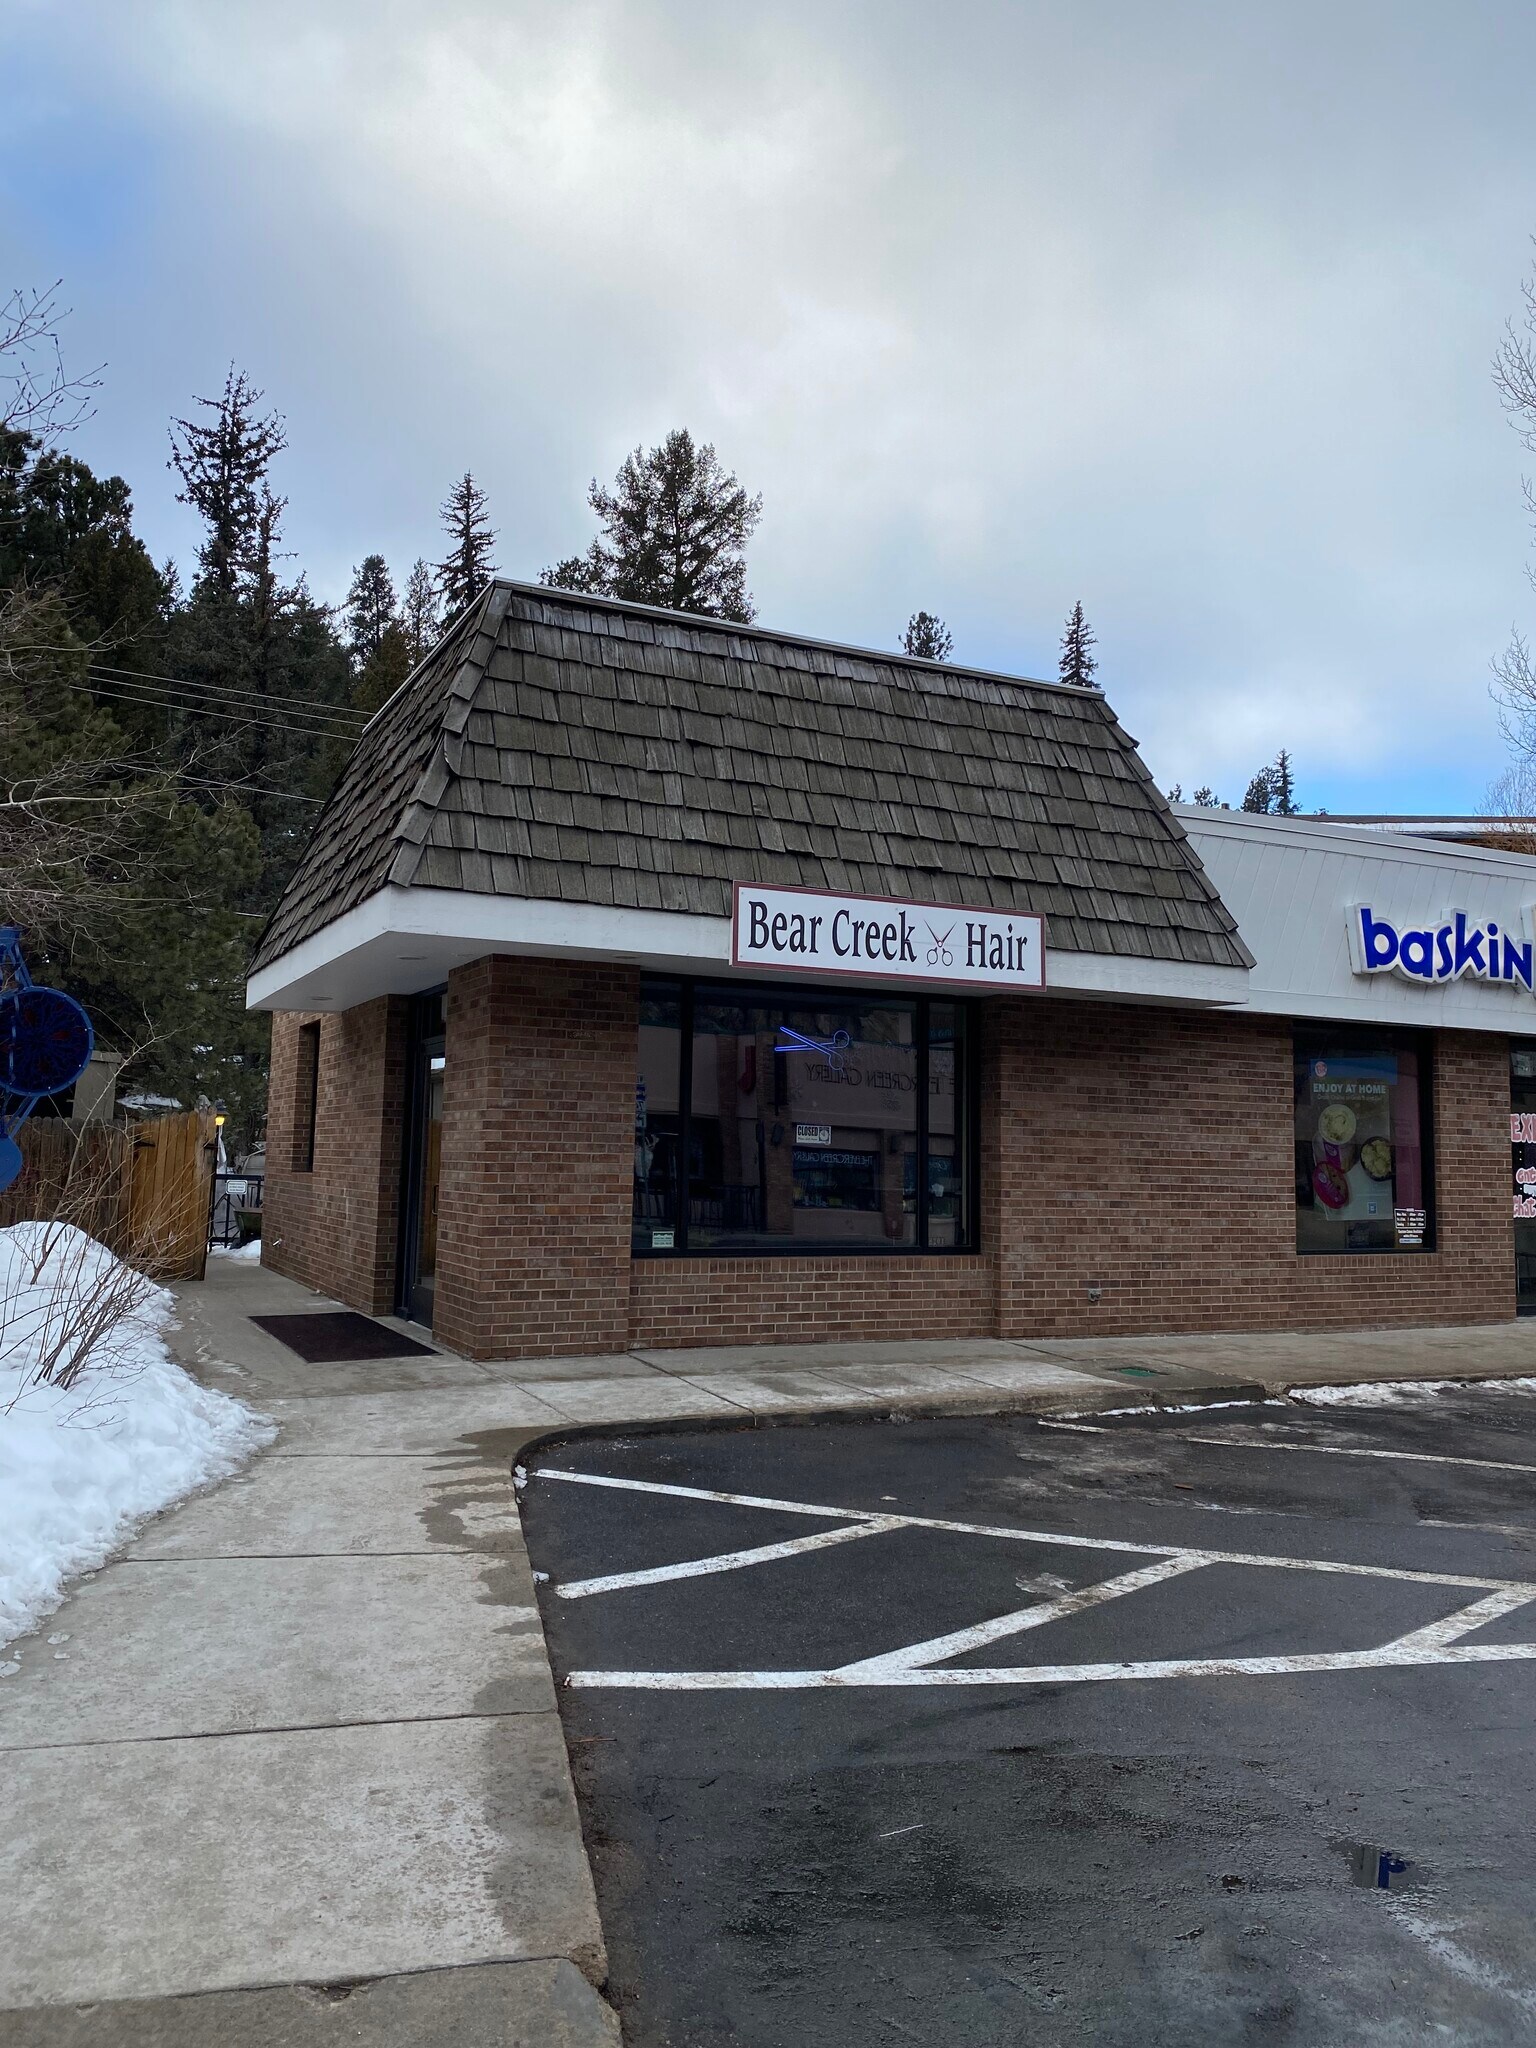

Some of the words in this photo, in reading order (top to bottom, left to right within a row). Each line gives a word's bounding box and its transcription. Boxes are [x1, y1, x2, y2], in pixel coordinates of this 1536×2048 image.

[748, 901, 822, 953] Bear
[831, 909, 917, 963] Creek
[965, 922, 1028, 972] Hair
[1313, 1083, 1343, 1093] ENJOY
[1345, 1084, 1357, 1093] AT
[1359, 1085, 1386, 1094] HOME
[797, 1126, 819, 1136] CLOSED
